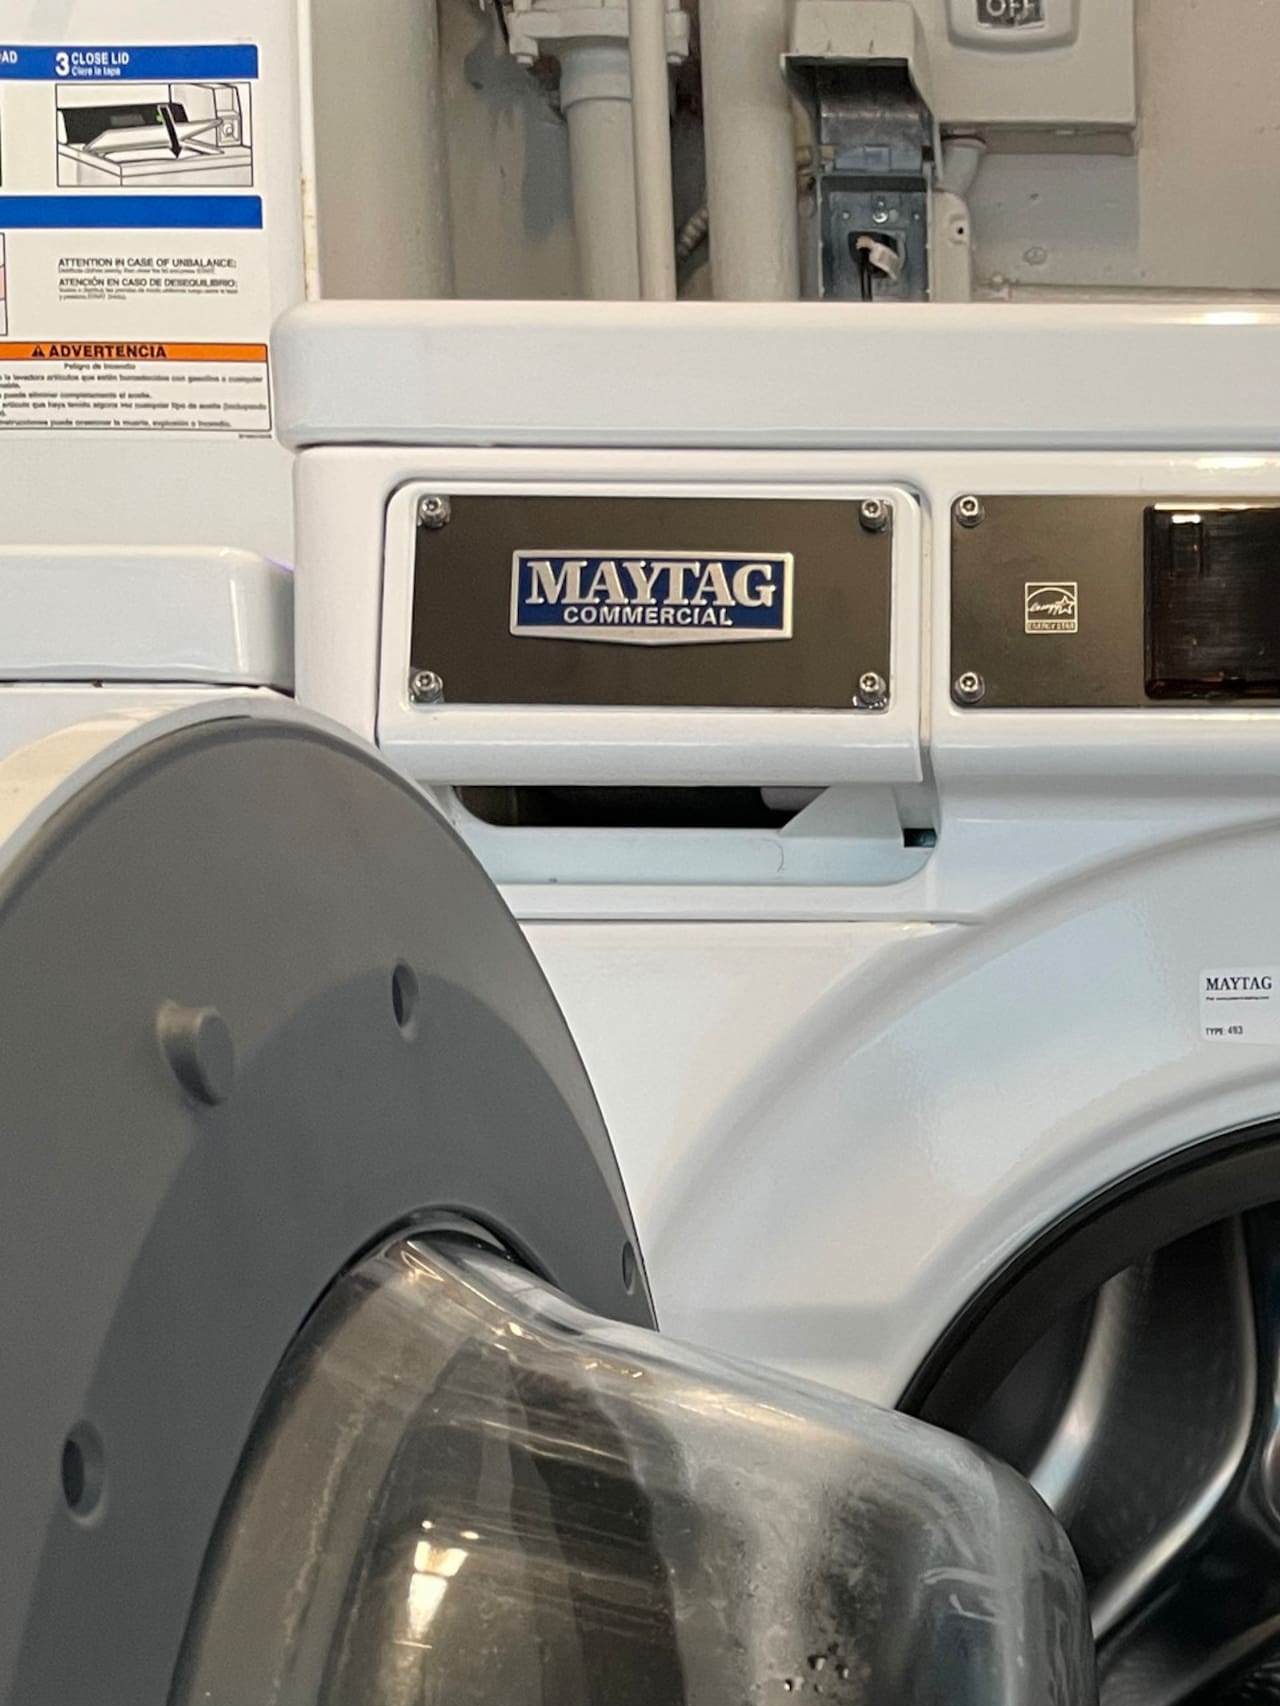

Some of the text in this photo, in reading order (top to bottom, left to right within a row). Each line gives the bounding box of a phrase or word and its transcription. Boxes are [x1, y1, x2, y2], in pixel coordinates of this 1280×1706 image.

[55, 52, 70, 76] 3
[71, 52, 130, 65] CLOSE LID
[58, 258, 113, 268] ATTENTION
[114, 258, 125, 268] IN
[127, 258, 153, 268] CASE
[156, 258, 169, 268] OF
[58, 276, 105, 287] ATENCIÓN
[106, 278, 120, 287] EN
[121, 278, 148, 287] CASO
[150, 278, 162, 287] DE
[49, 345, 167, 358] ADVERTENCIA
[525, 560, 777, 608] MAYTAG
[562, 606, 733, 626] COMMERCIAL
[1206, 976, 1272, 991] MAYTAG
